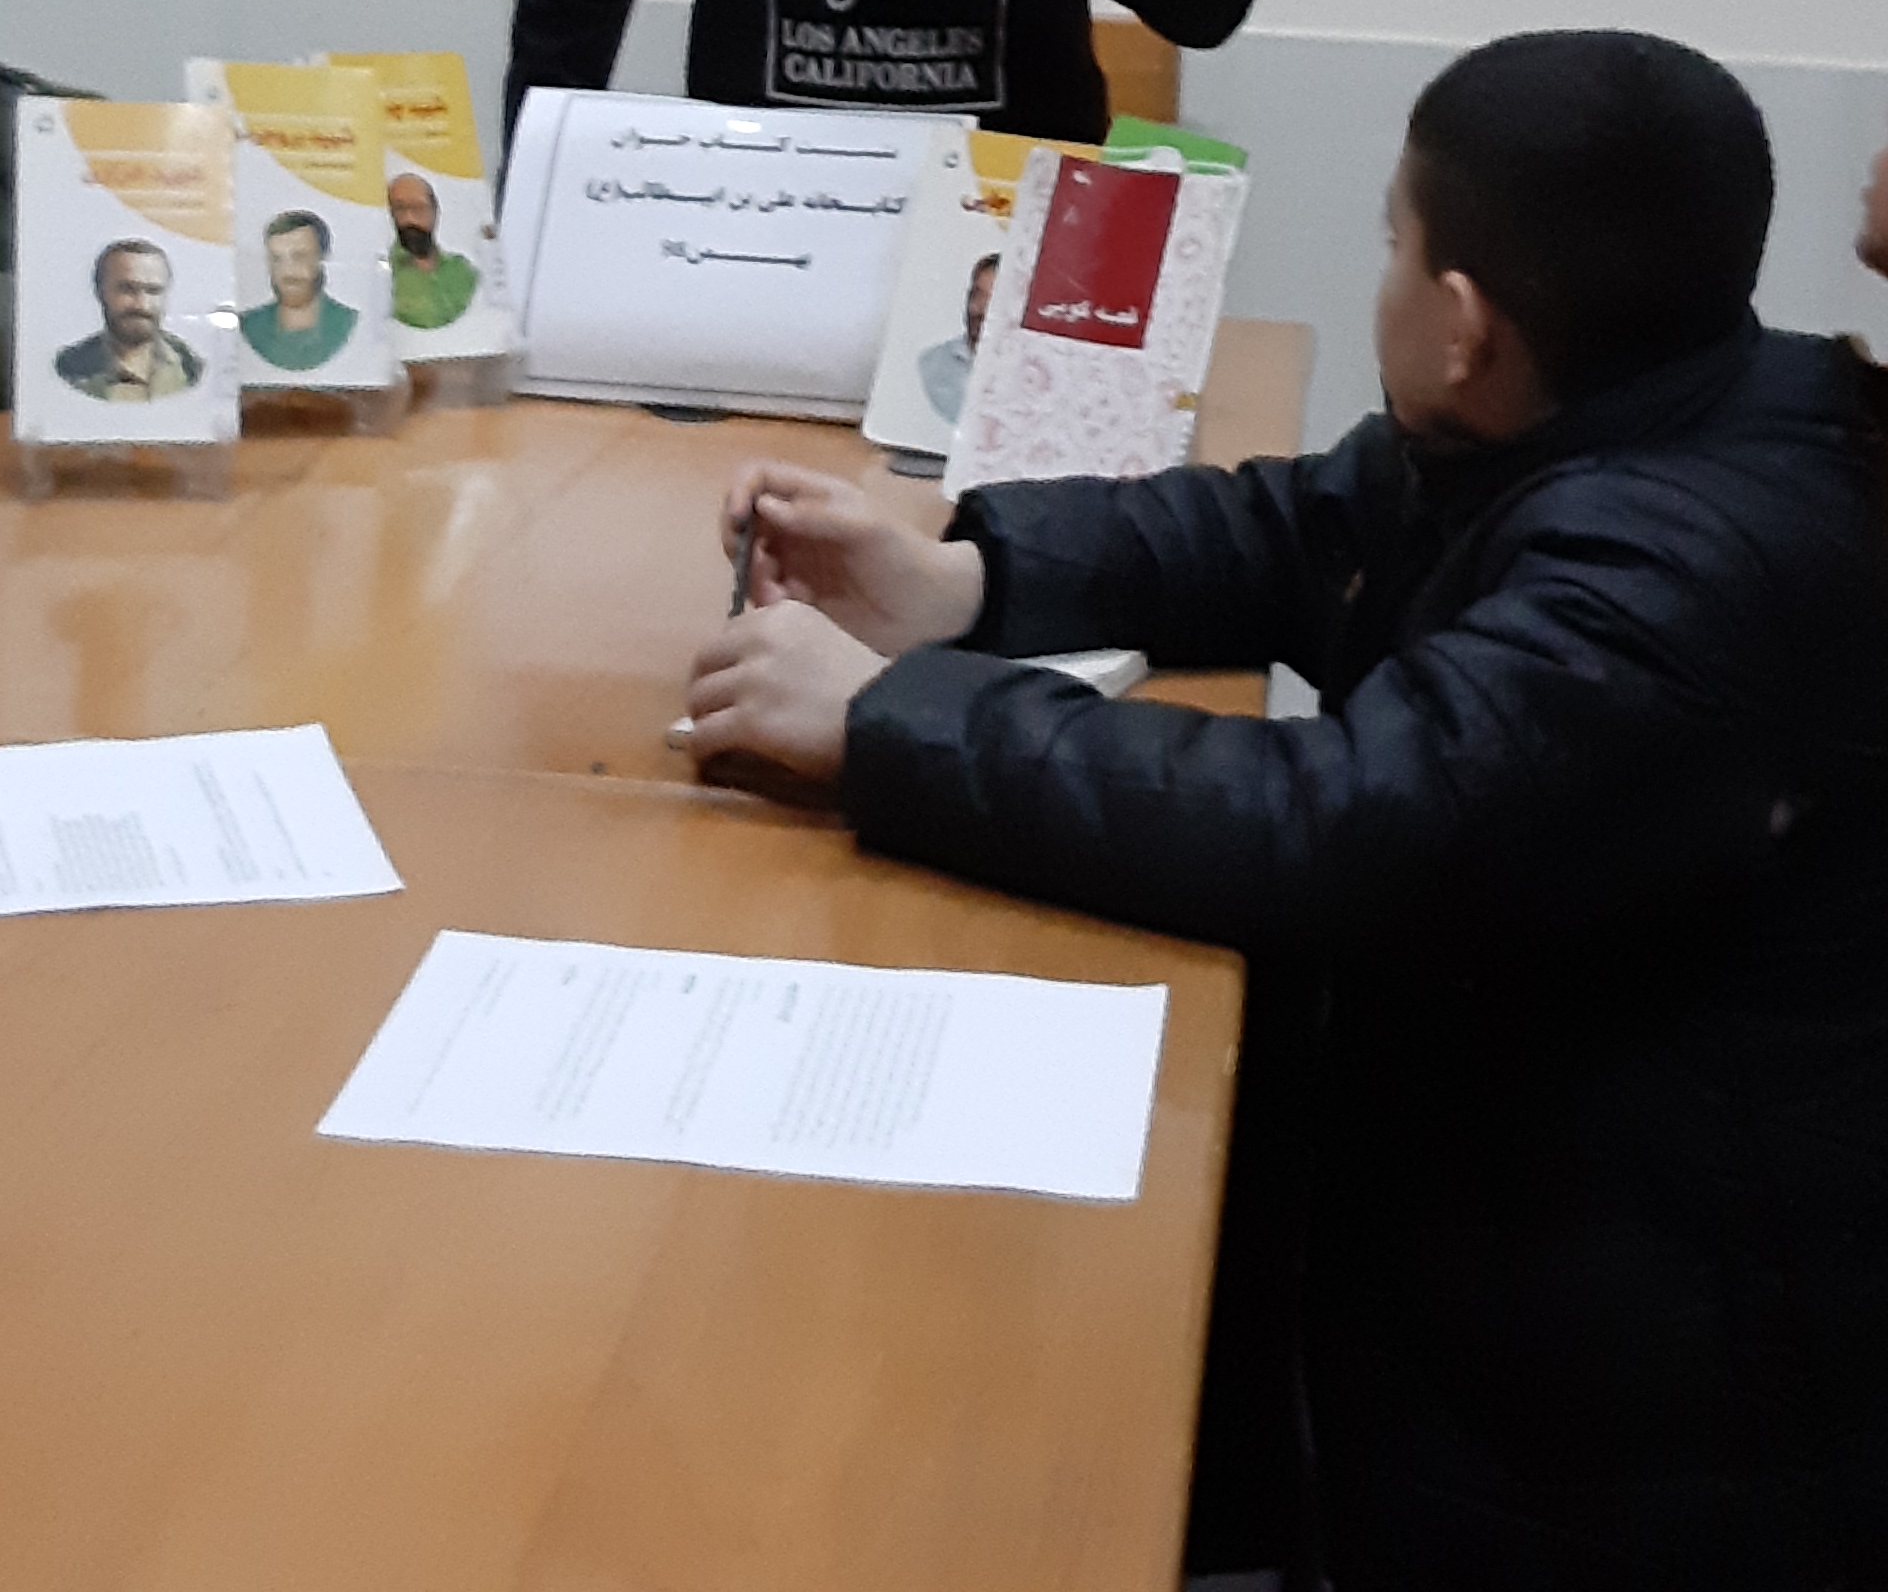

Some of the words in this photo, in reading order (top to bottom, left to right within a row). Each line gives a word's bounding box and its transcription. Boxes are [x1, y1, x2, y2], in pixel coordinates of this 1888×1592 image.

[781, 18, 836, 53] LOS
[840, 25, 984, 56] ANGELES
[783, 52, 978, 91] CALIFORNIA
